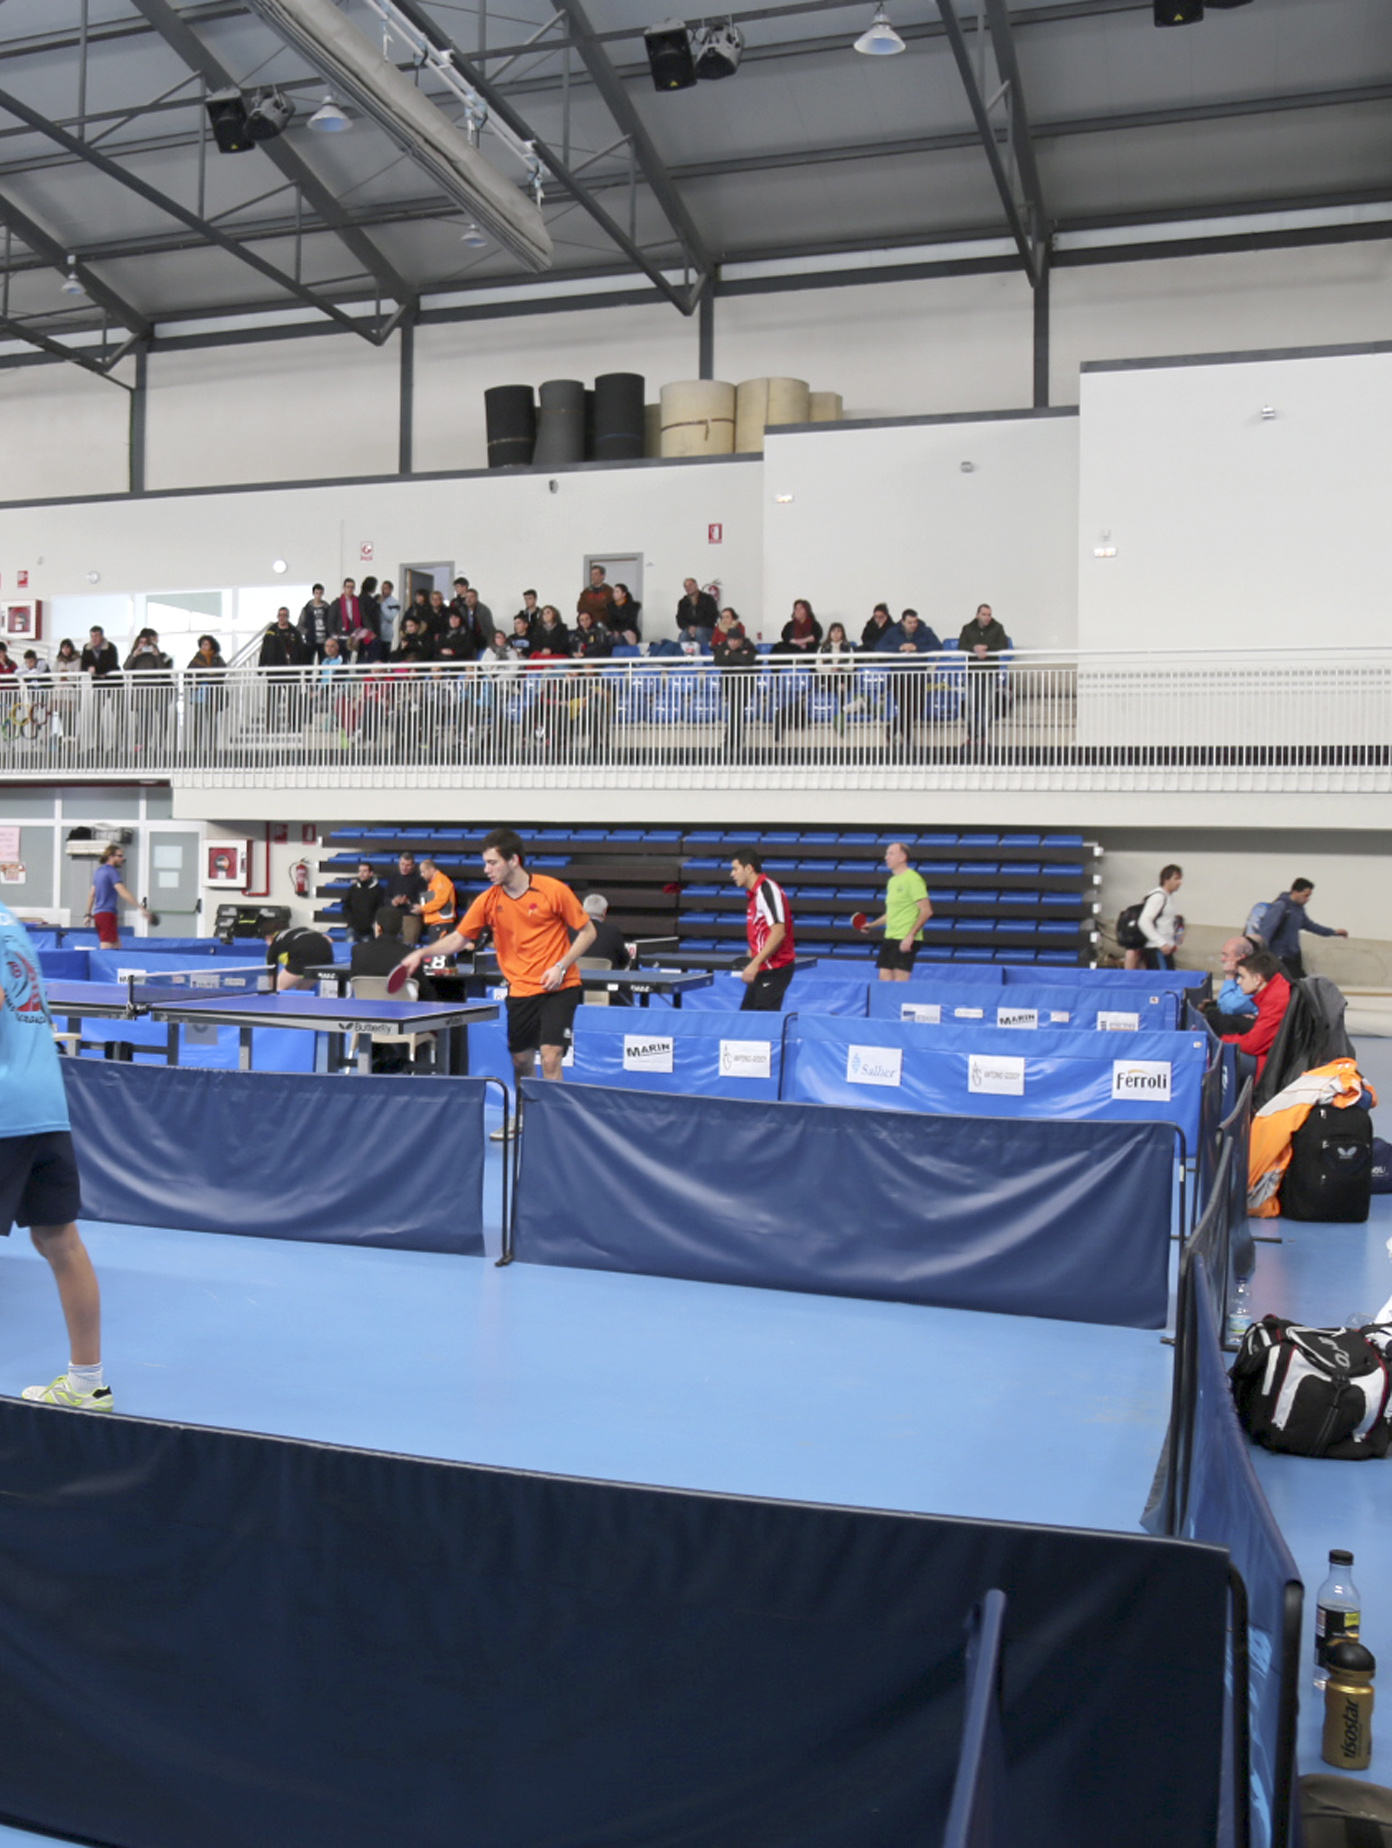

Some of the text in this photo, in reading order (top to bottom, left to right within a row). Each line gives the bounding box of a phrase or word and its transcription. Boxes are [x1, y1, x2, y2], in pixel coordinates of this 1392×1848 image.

[999, 1013, 1035, 1026] MARIN
[626, 1043, 670, 1057] MARIN
[1116, 1070, 1167, 1091] Ferroli
